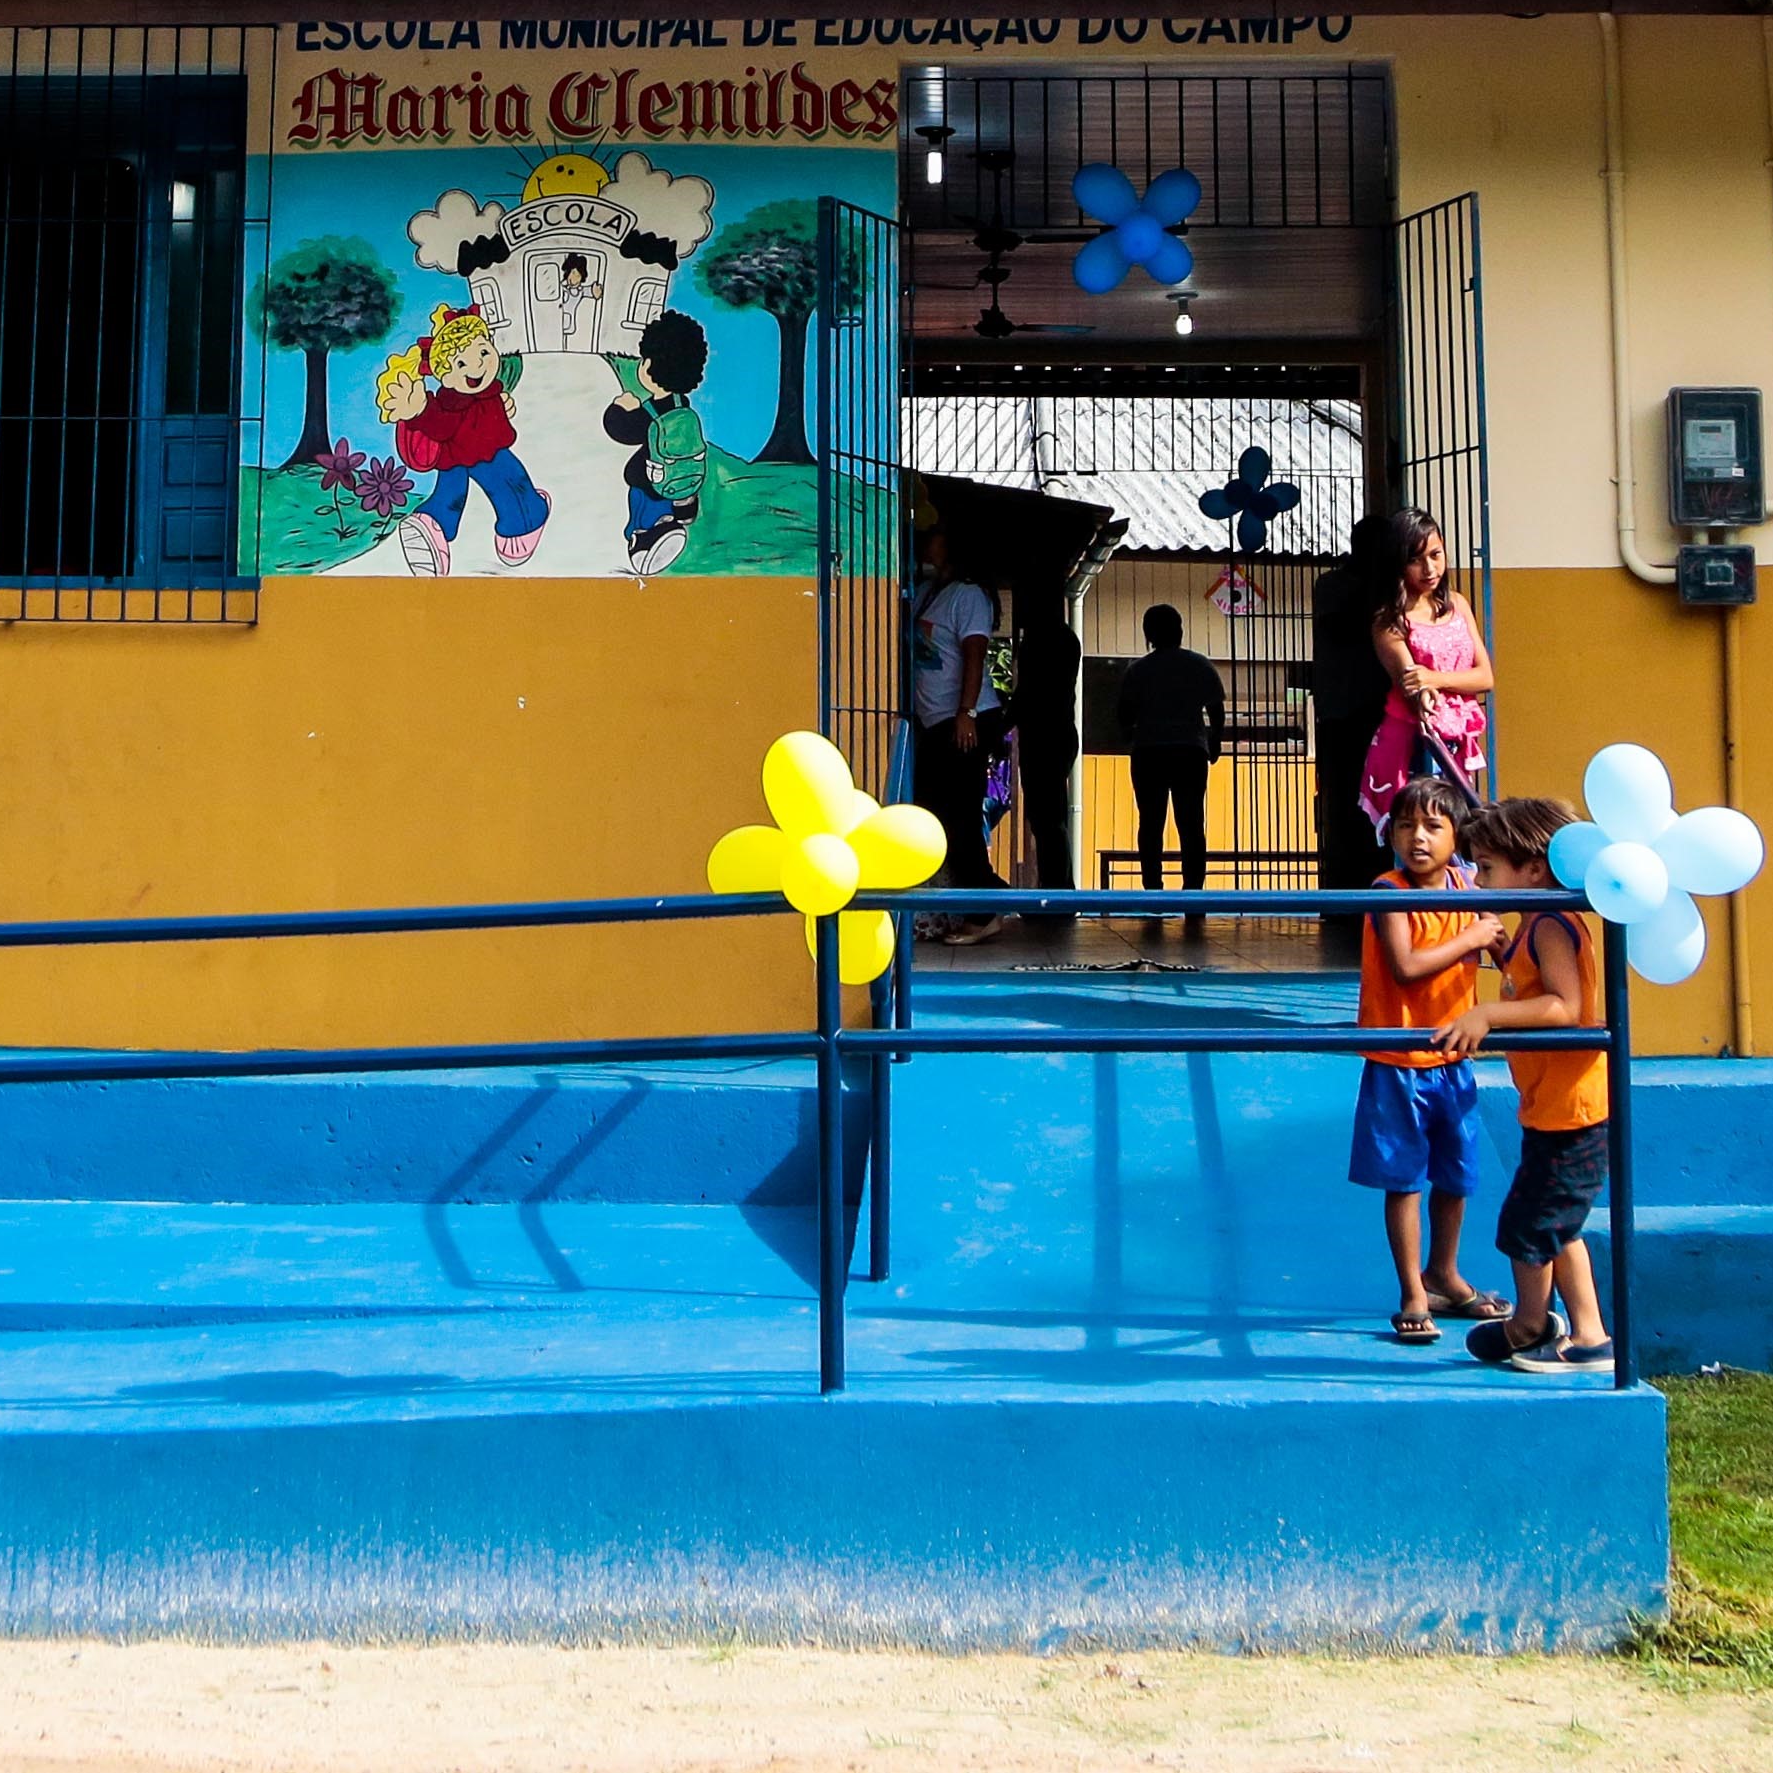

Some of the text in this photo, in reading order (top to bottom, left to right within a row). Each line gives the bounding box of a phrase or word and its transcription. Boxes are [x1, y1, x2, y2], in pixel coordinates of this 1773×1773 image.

[295, 19, 481, 51] ESCOLA
[499, 18, 727, 49] MUNICIPAL
[742, 18, 797, 47] DE
[1078, 17, 1148, 44] DO
[1162, 15, 1353, 44] CAMPO
[287, 62, 899, 144] Maria Clemildes
[510, 203, 623, 240] ESCOLA
